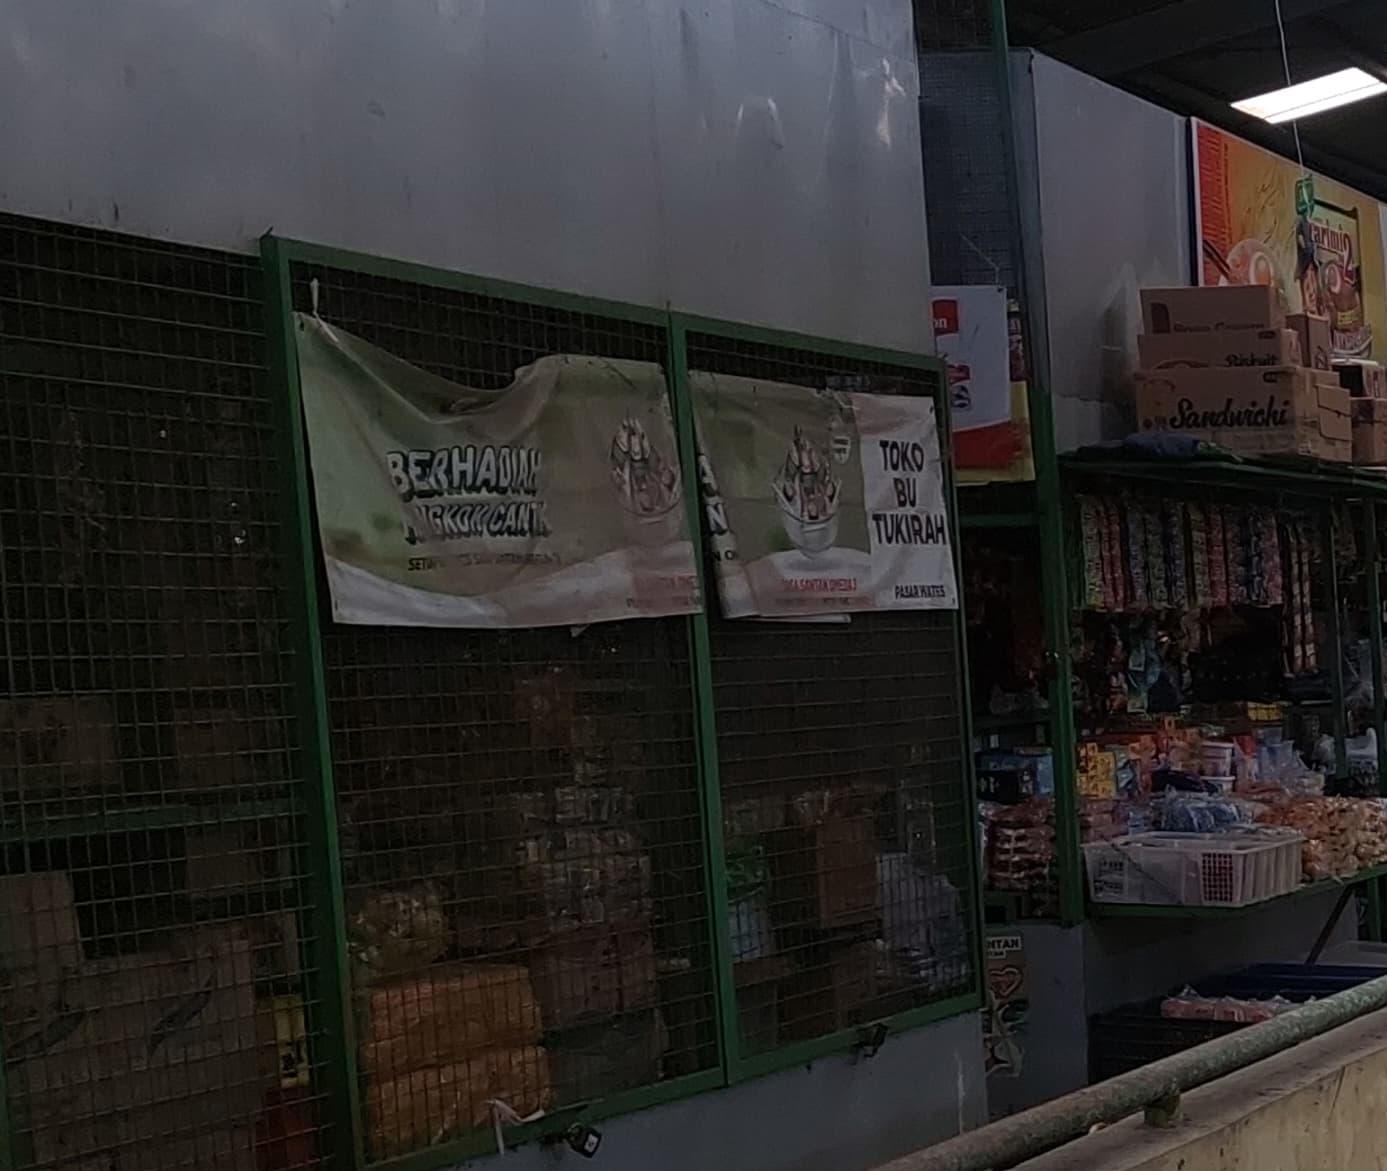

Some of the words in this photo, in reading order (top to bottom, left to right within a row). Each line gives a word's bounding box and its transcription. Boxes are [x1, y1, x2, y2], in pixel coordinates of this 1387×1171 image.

[1308, 219, 1345, 254] arimi
[879, 439, 925, 473] TOKO
[893, 477, 917, 508] BU
[872, 513, 947, 545] TUKIRAH
[895, 585, 920, 598] PASAR
